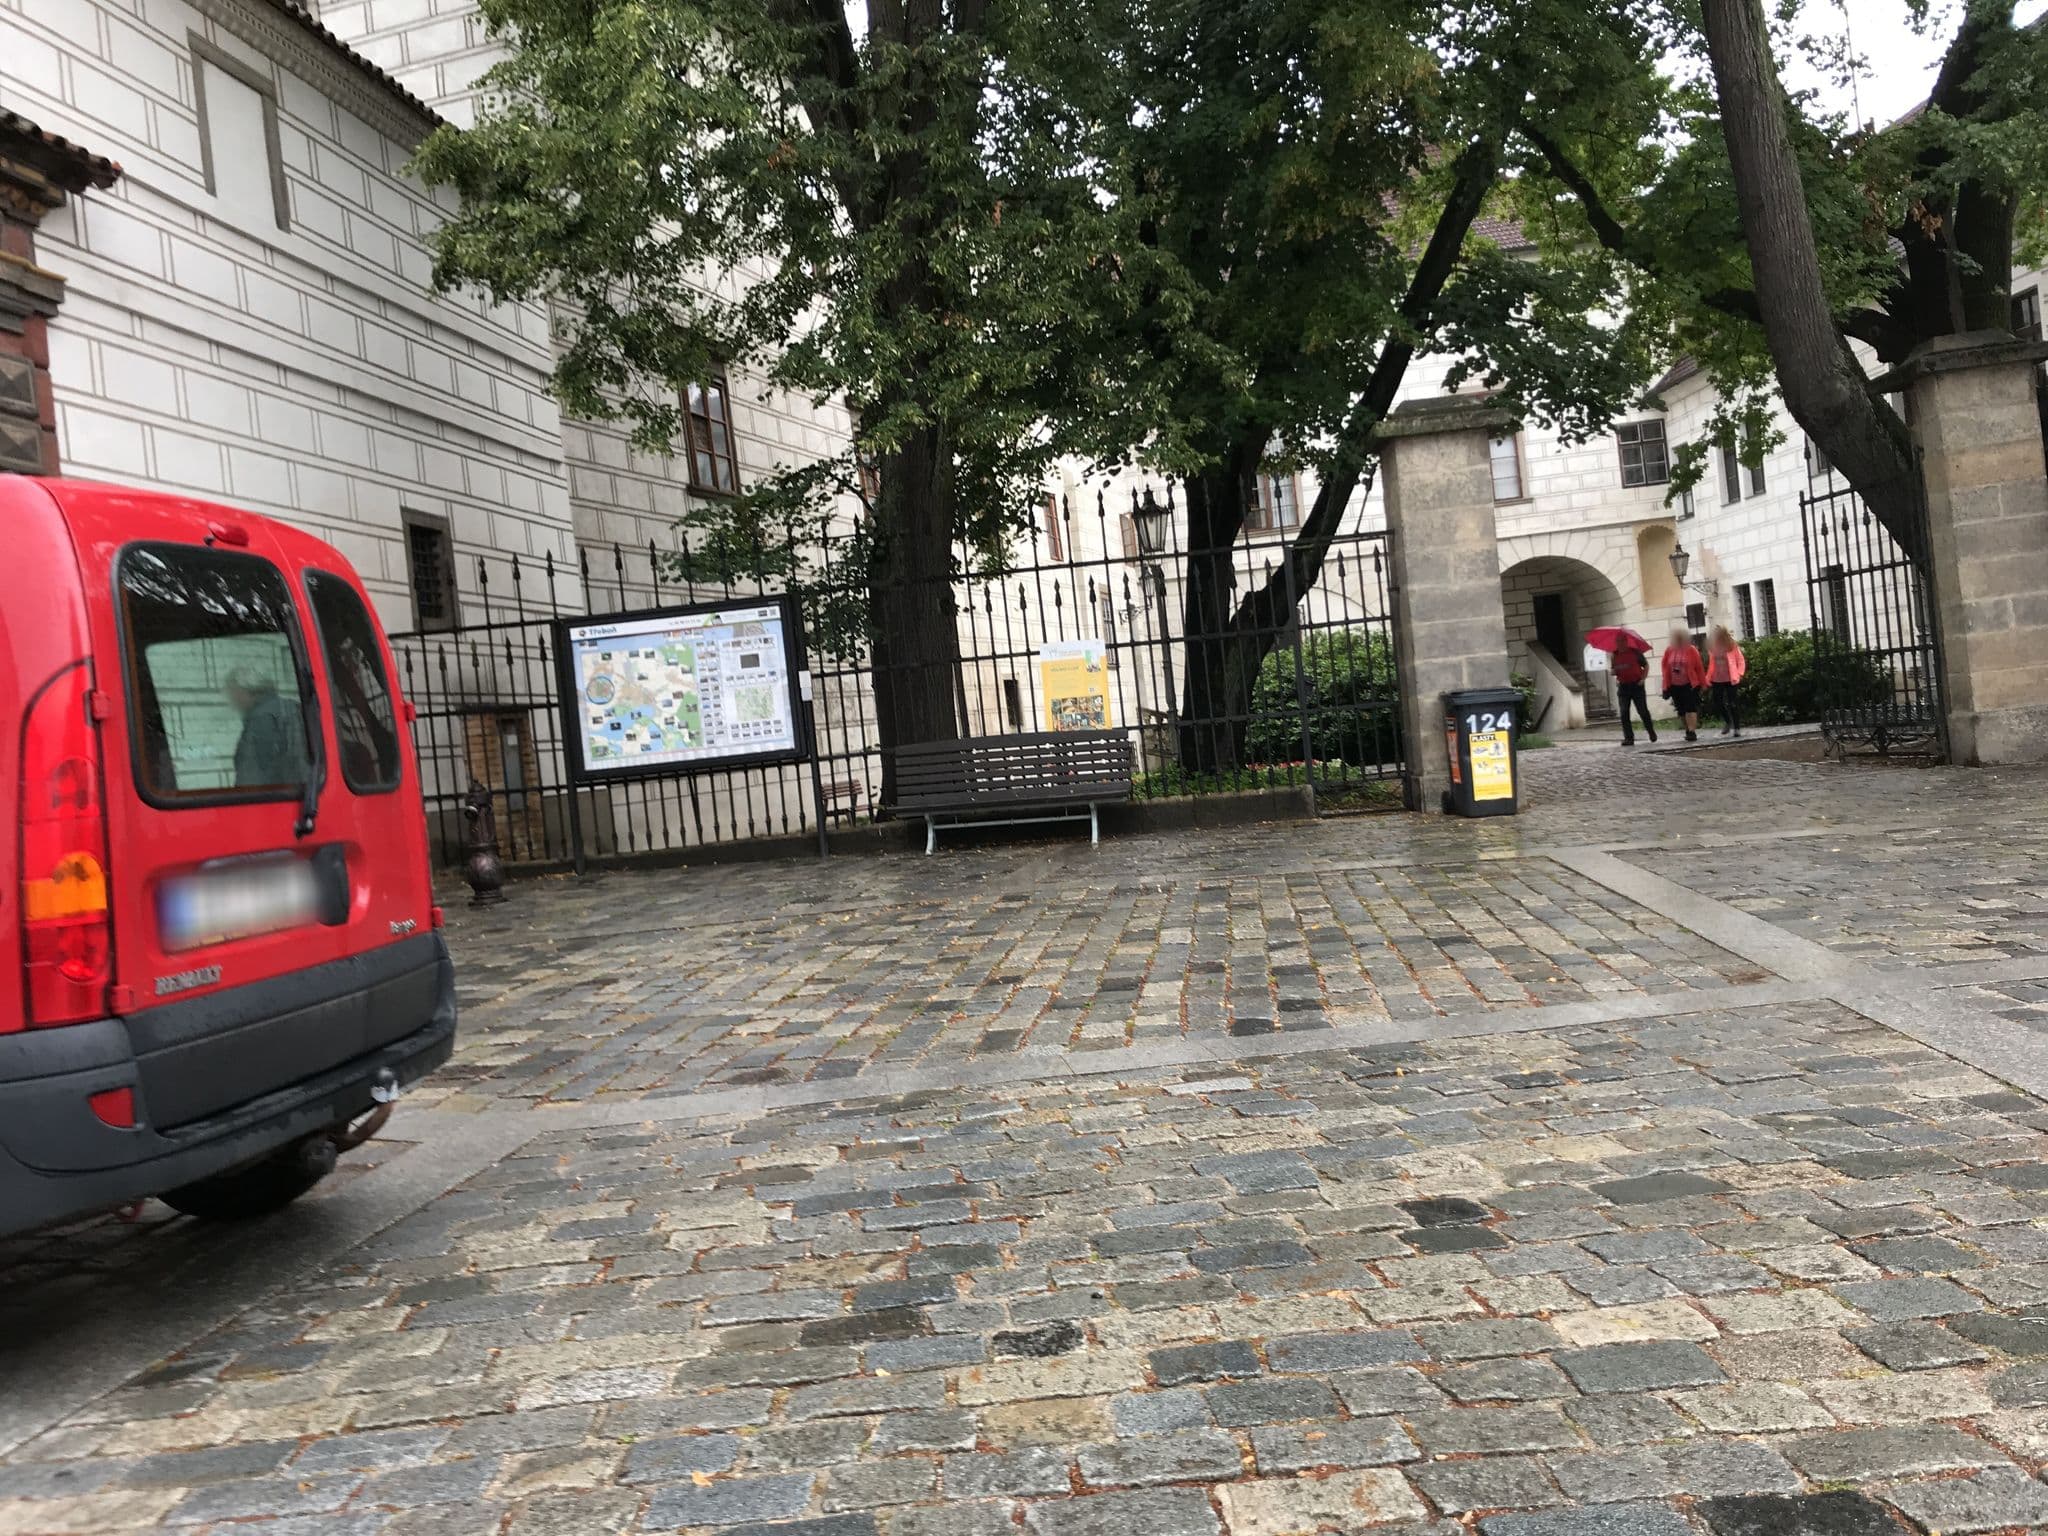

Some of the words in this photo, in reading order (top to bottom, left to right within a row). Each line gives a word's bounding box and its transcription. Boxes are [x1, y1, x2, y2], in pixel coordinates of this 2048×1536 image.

[1466, 711, 1512, 733] 124
[1471, 734, 1495, 742] PLASTY
[154, 966, 222, 995] RENAULT
